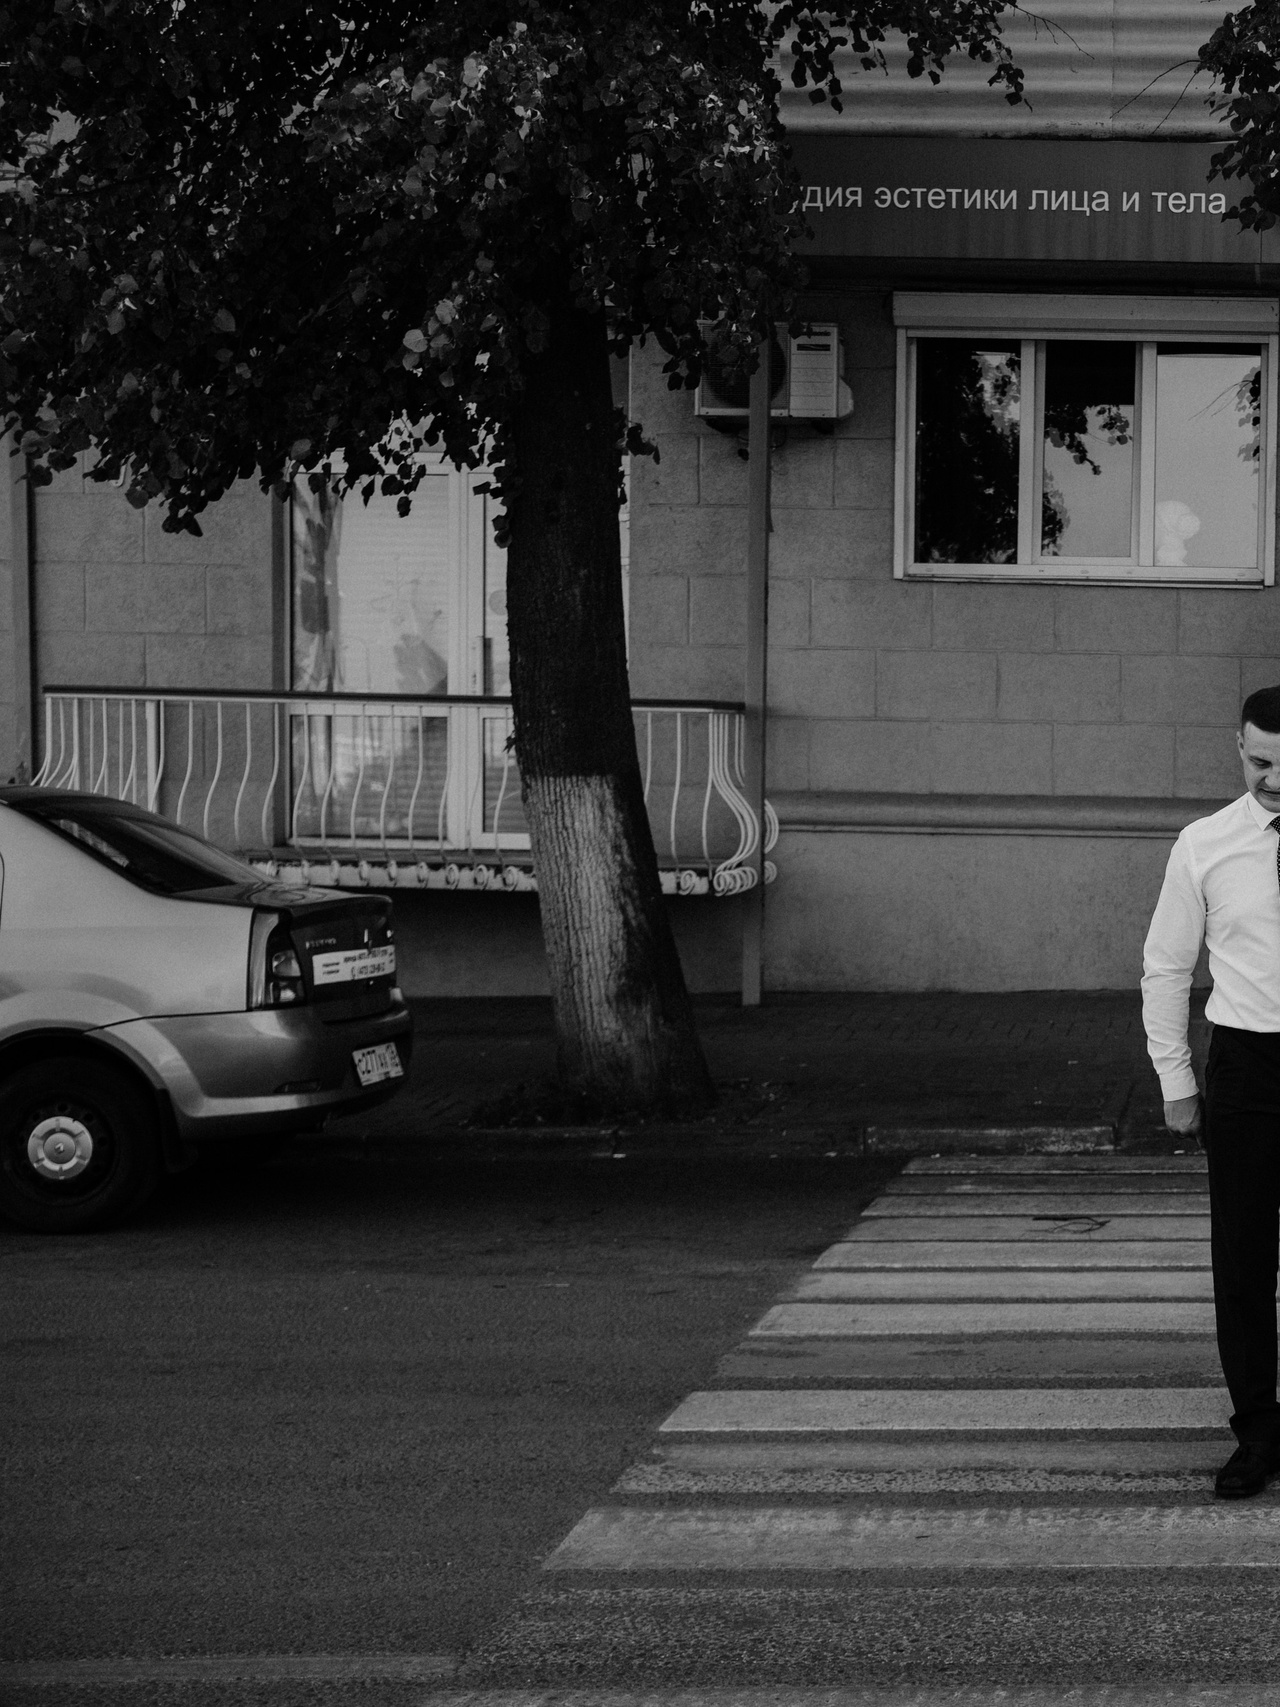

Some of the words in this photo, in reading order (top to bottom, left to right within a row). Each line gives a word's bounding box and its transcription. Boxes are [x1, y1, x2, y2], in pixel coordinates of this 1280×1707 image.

[790, 186, 862, 212] дия
[874, 187, 1018, 210] эстетики
[1028, 189, 1110, 217] лица
[1122, 191, 1140, 213] и
[1151, 191, 1226, 215] тела
